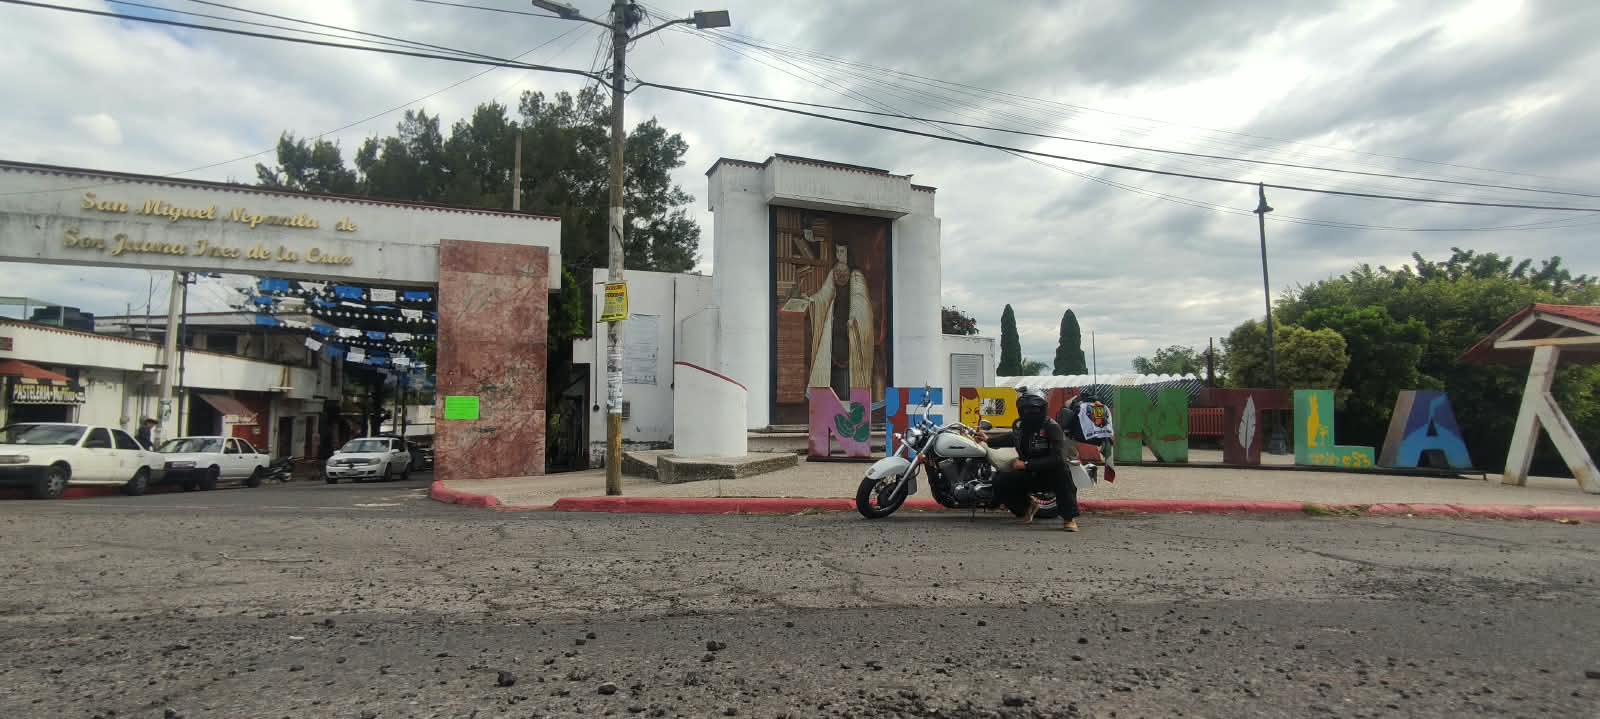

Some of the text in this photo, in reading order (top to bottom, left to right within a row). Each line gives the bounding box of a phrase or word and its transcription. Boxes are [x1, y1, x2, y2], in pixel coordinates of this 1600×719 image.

[82, 192, 128, 214] San
[136, 199, 216, 223] Miguel
[336, 216, 357, 232] de
[111, 233, 186, 256] Juana
[247, 243, 272, 260] de
[277, 245, 298, 262] la
[305, 247, 353, 265] Cruz
